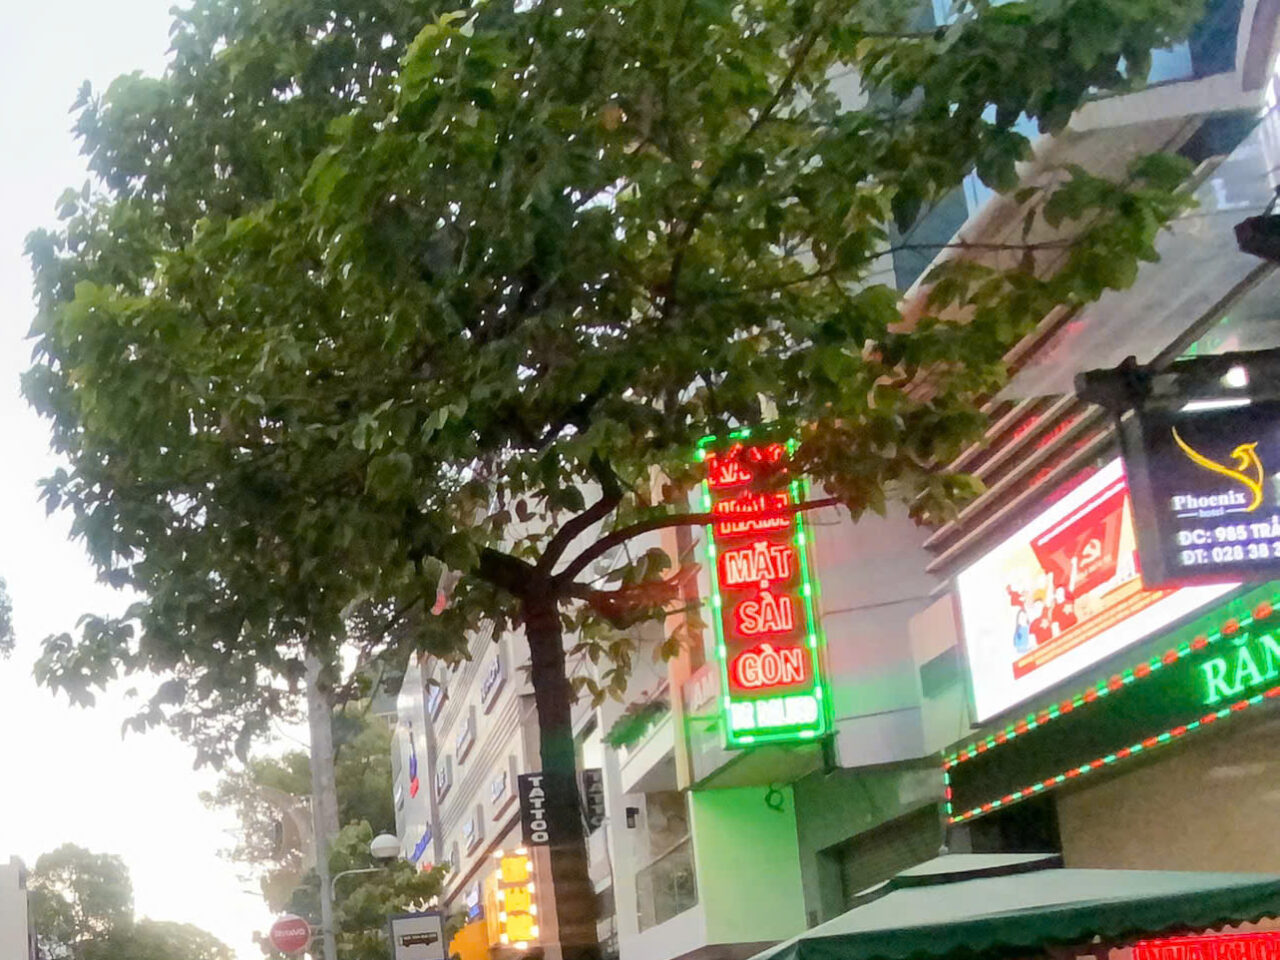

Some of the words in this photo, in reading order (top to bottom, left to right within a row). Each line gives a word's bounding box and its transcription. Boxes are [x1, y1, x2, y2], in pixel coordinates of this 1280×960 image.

[1171, 490, 1246, 511] Phoenix
[725, 541, 792, 589] MẶT
[739, 591, 793, 634] SÀI
[738, 643, 805, 687] GÒN
[527, 775, 549, 842] TATTOO
